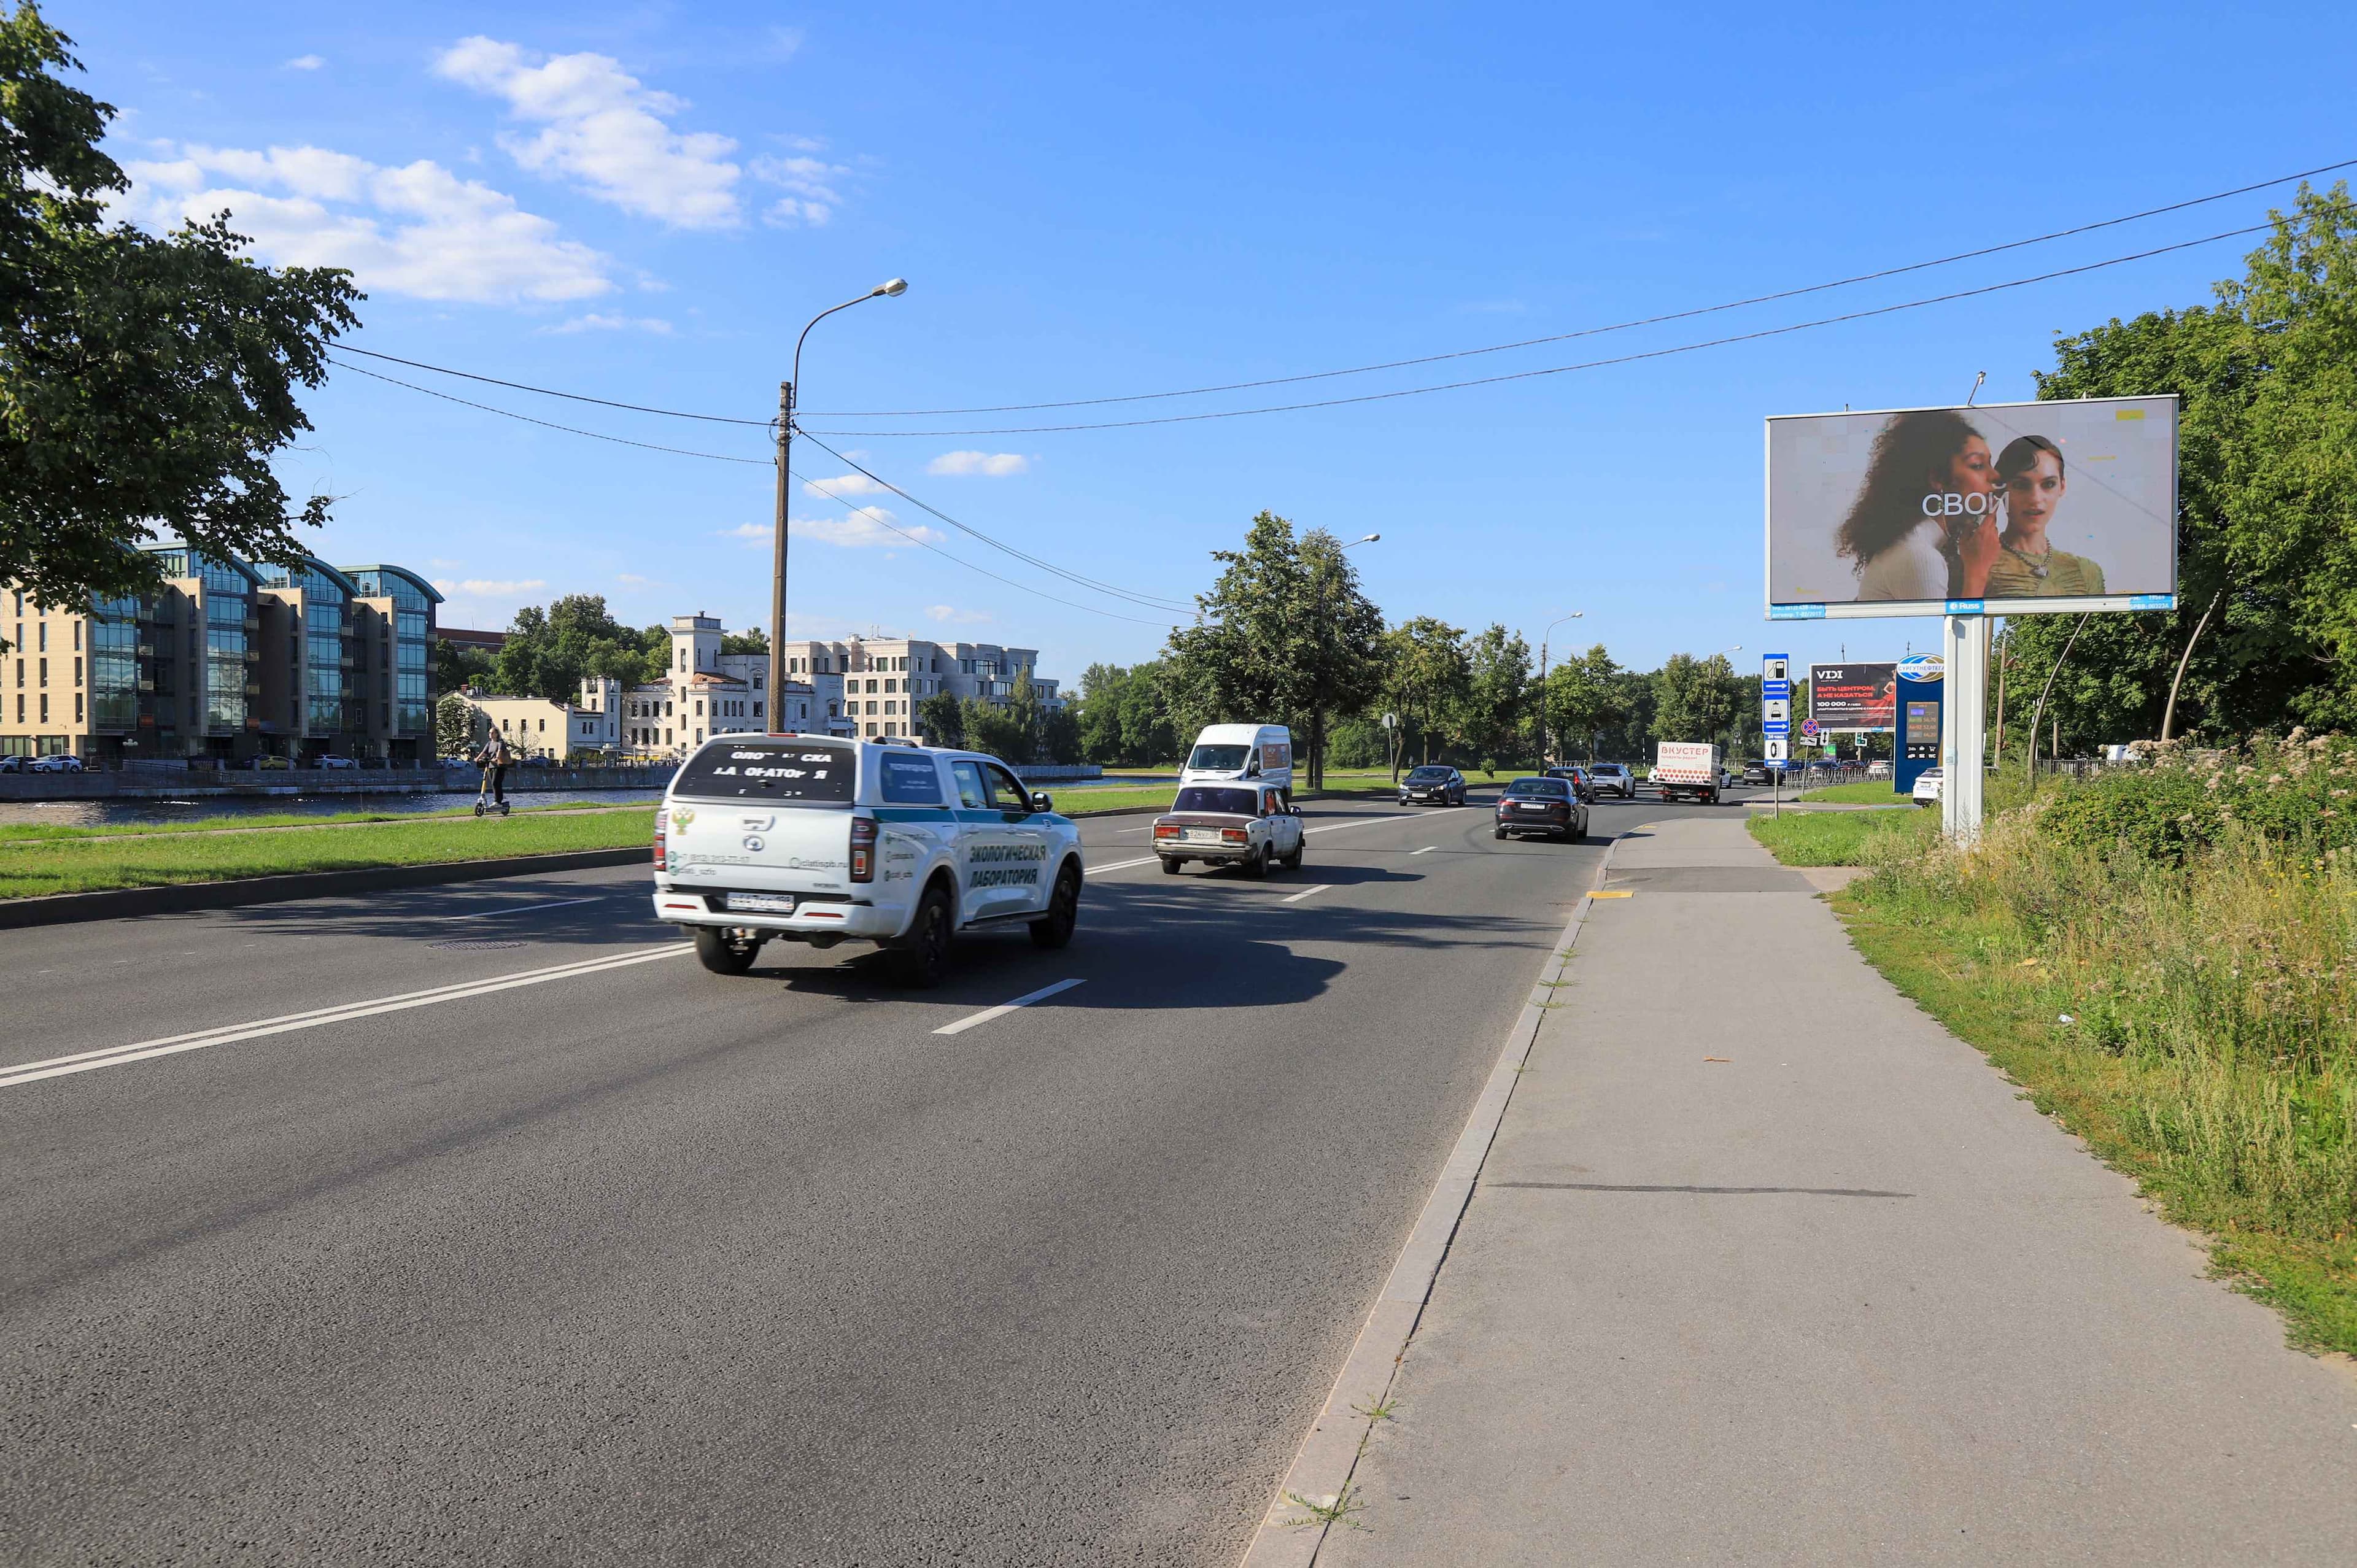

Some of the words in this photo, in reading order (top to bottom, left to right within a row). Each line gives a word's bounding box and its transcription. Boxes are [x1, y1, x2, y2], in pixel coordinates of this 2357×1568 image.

[1922, 482, 2010, 517] СВОЙ
[1817, 670, 1843, 679] VIDI
[1662, 746, 1709, 755] ВКУСТЕР
[970, 845, 1046, 863] ЭКОЛОГИЧЕСКАЯ
[970, 869, 1038, 887] ЛАБОРАТОРИЯ
